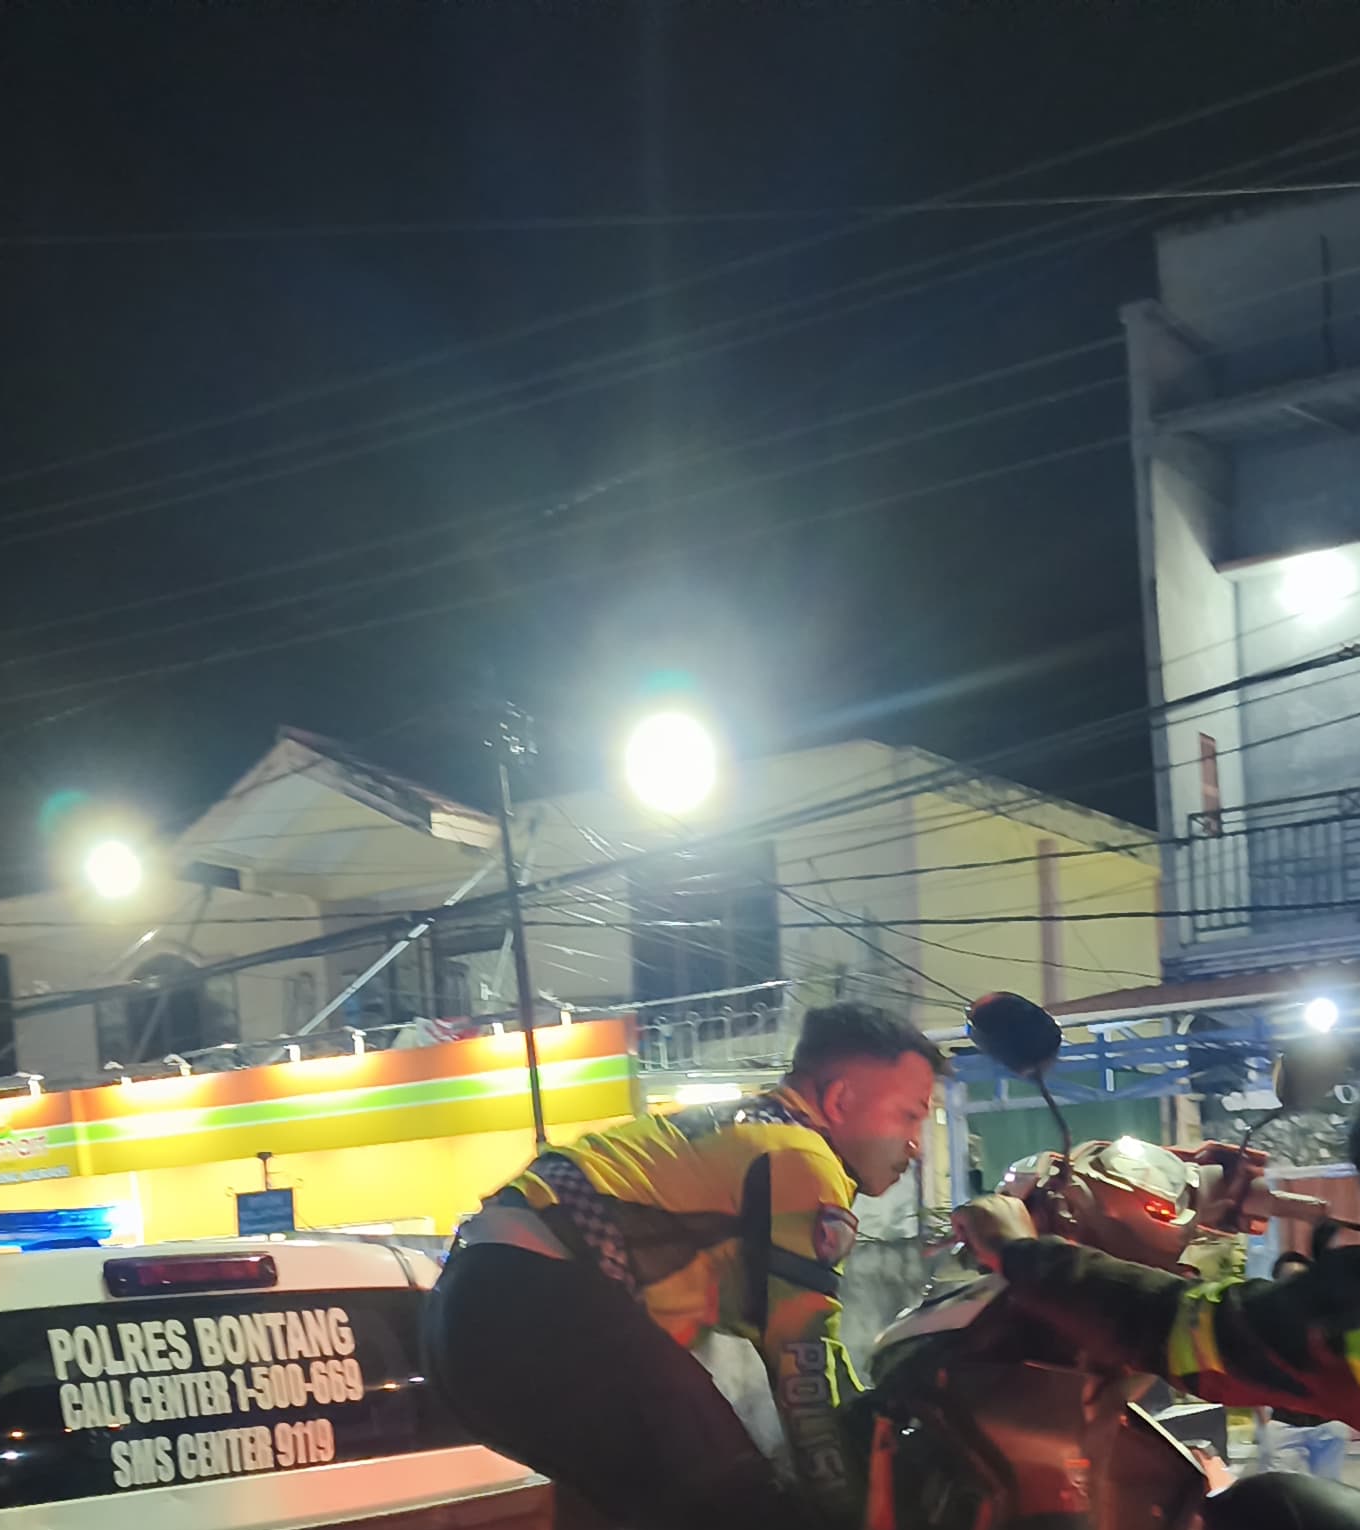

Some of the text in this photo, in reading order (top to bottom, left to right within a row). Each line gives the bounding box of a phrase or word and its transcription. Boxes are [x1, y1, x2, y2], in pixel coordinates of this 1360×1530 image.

[47, 1306, 358, 1381] POLRES BONTANG
[59, 1358, 365, 1431] CALL CENTER 1-500-669
[110, 1417, 336, 1489] SMS CENTER 9119
